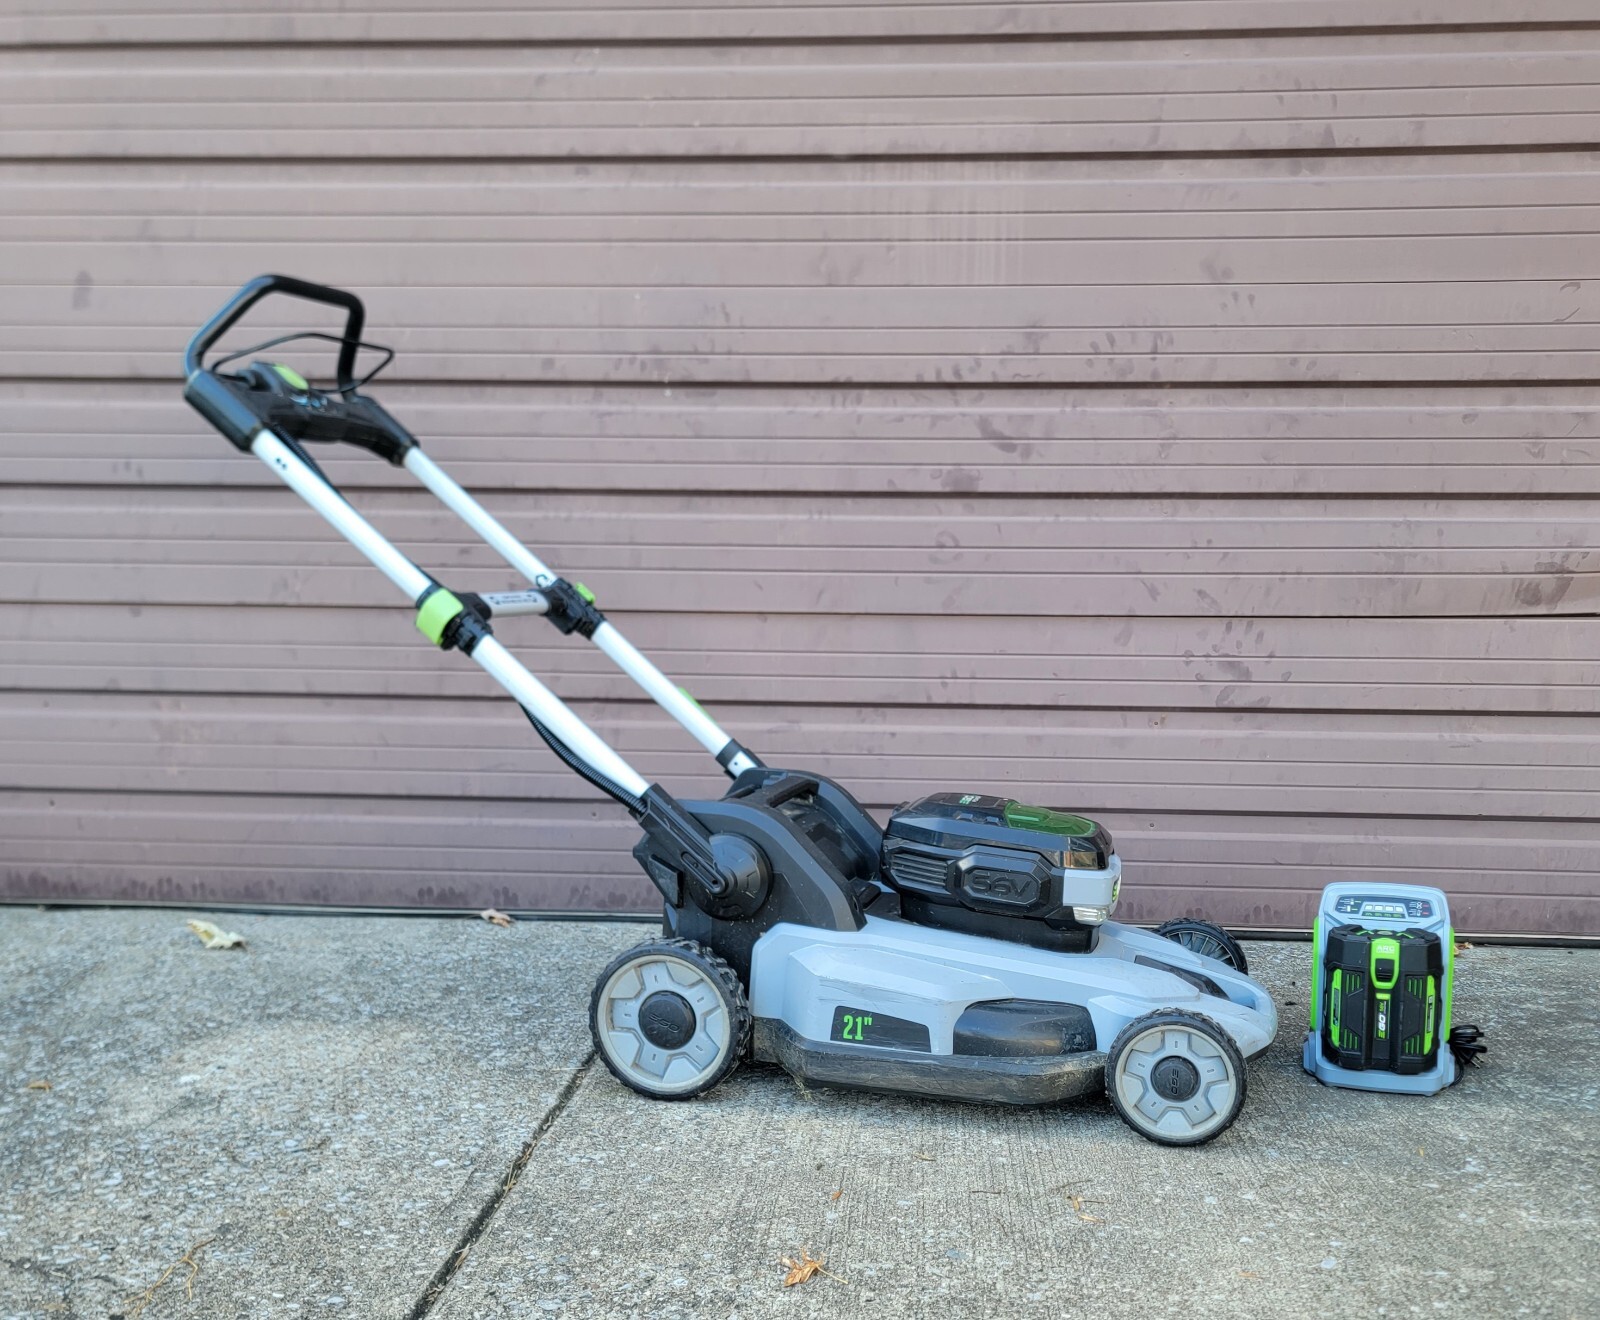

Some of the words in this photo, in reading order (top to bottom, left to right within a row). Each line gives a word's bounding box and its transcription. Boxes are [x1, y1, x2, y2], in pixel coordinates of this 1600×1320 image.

[972, 870, 1031, 898] 56V
[648, 1013, 680, 1033] EGO
[842, 1014, 873, 1041] 21"
[1378, 1013, 1386, 1039] EGO
[1170, 1068, 1179, 1095] EGO
